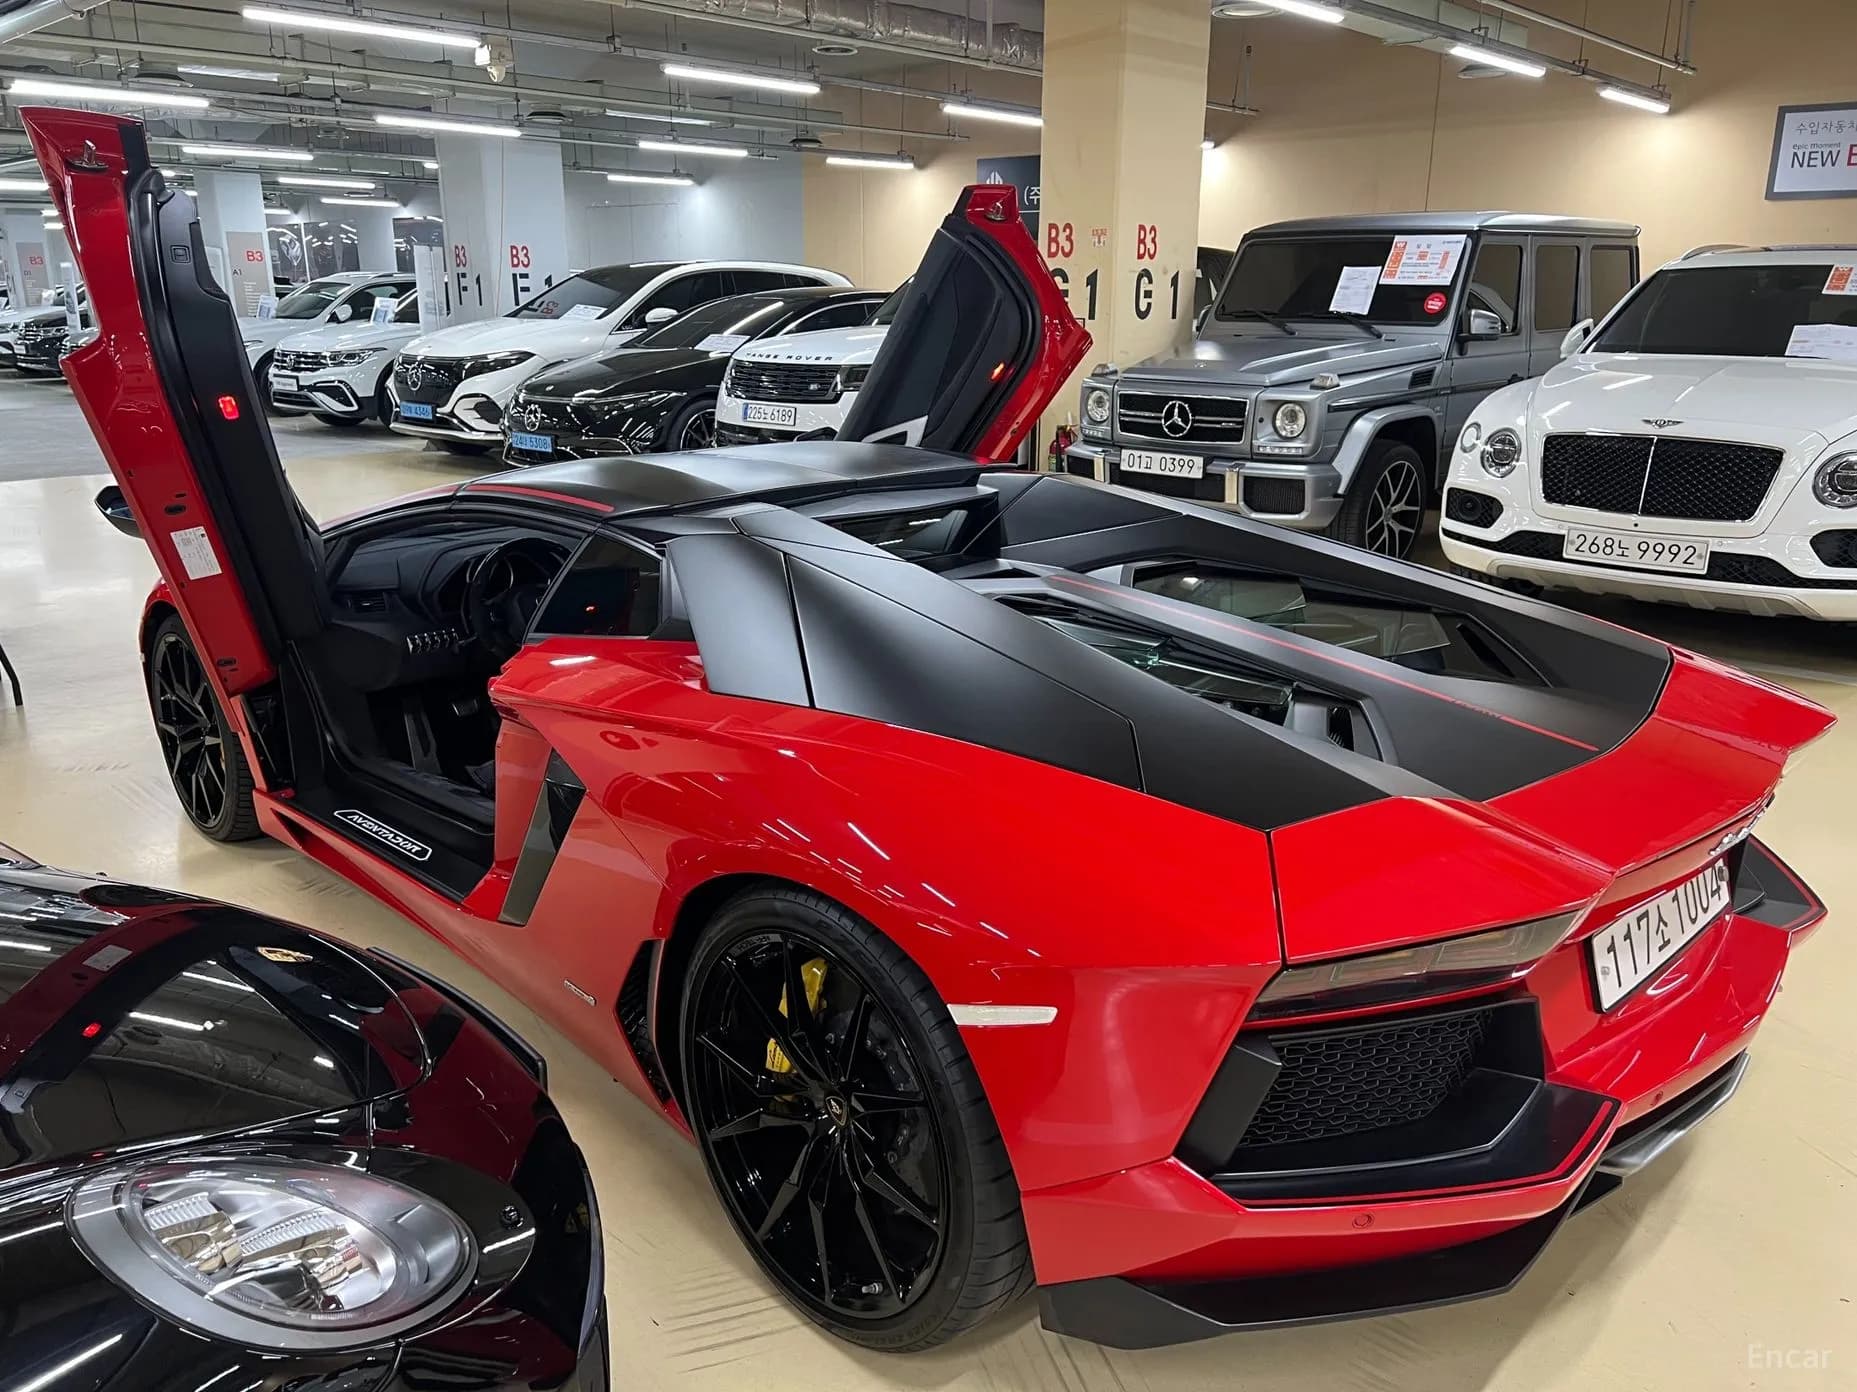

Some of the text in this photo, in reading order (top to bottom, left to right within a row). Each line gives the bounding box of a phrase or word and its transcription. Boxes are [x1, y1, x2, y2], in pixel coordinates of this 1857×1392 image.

[1791, 150, 1840, 168] NEW
[1047, 223, 1074, 258] B3
[1136, 224, 1157, 260] B3
[246, 250, 263, 262] B3
[455, 246, 467, 268] B3
[509, 245, 530, 268] B3
[1160, 456, 1195, 474] 0399
[1637, 541, 1697, 565] 9992
[347, 814, 423, 854] AVENTADOR
